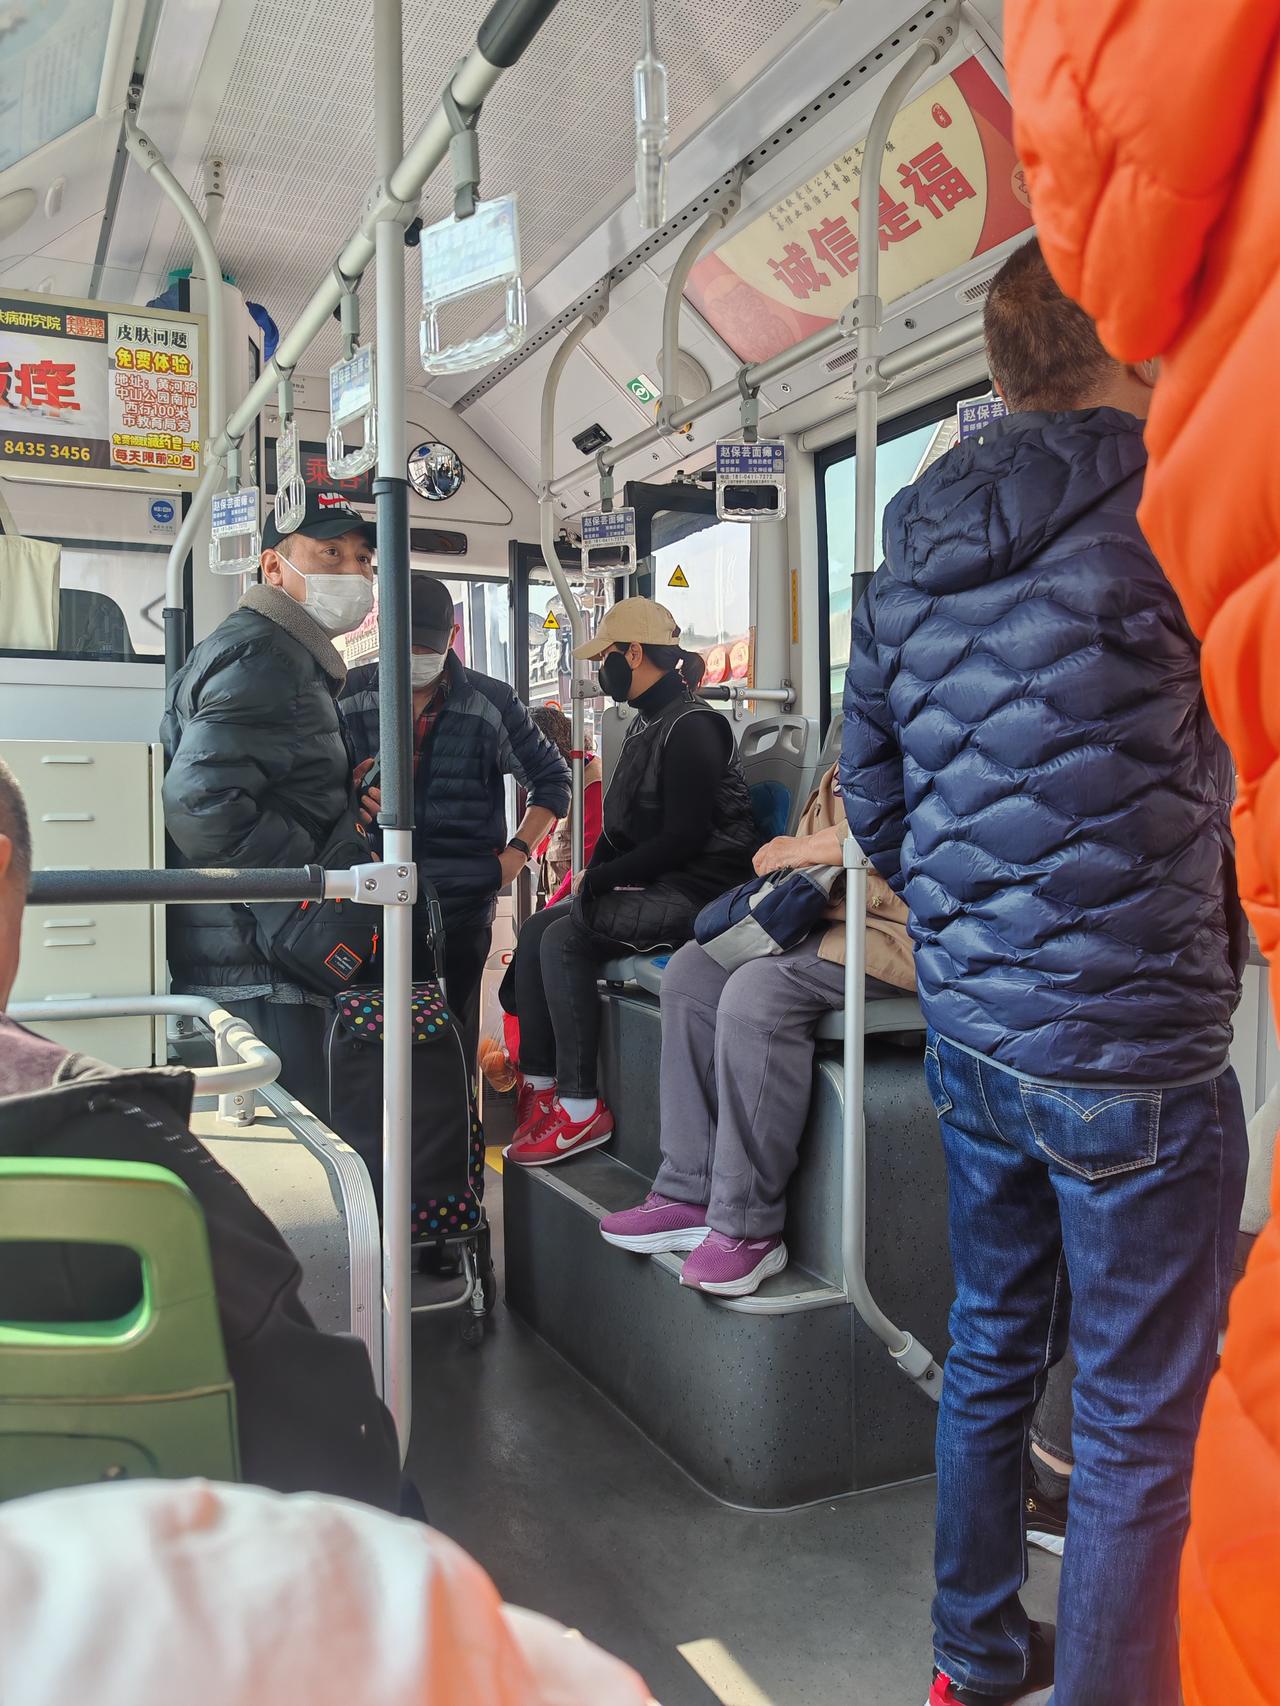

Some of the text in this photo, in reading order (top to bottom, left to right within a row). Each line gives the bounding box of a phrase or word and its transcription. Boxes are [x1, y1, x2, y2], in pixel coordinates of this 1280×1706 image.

[766, 141, 977, 299] 诚信是福
[117, 323, 188, 349] 皮肤问题
[115, 346, 192, 375] 免费体验
[115, 387, 198, 408] 中山公园南门
[124, 400, 189, 419] 西行100米
[963, 402, 1009, 423] 赵保芸
[122, 414, 191, 433] 市教育局旁
[4, 440, 91, 461] 8435 3456
[114, 449, 195, 469] 每天限前20名
